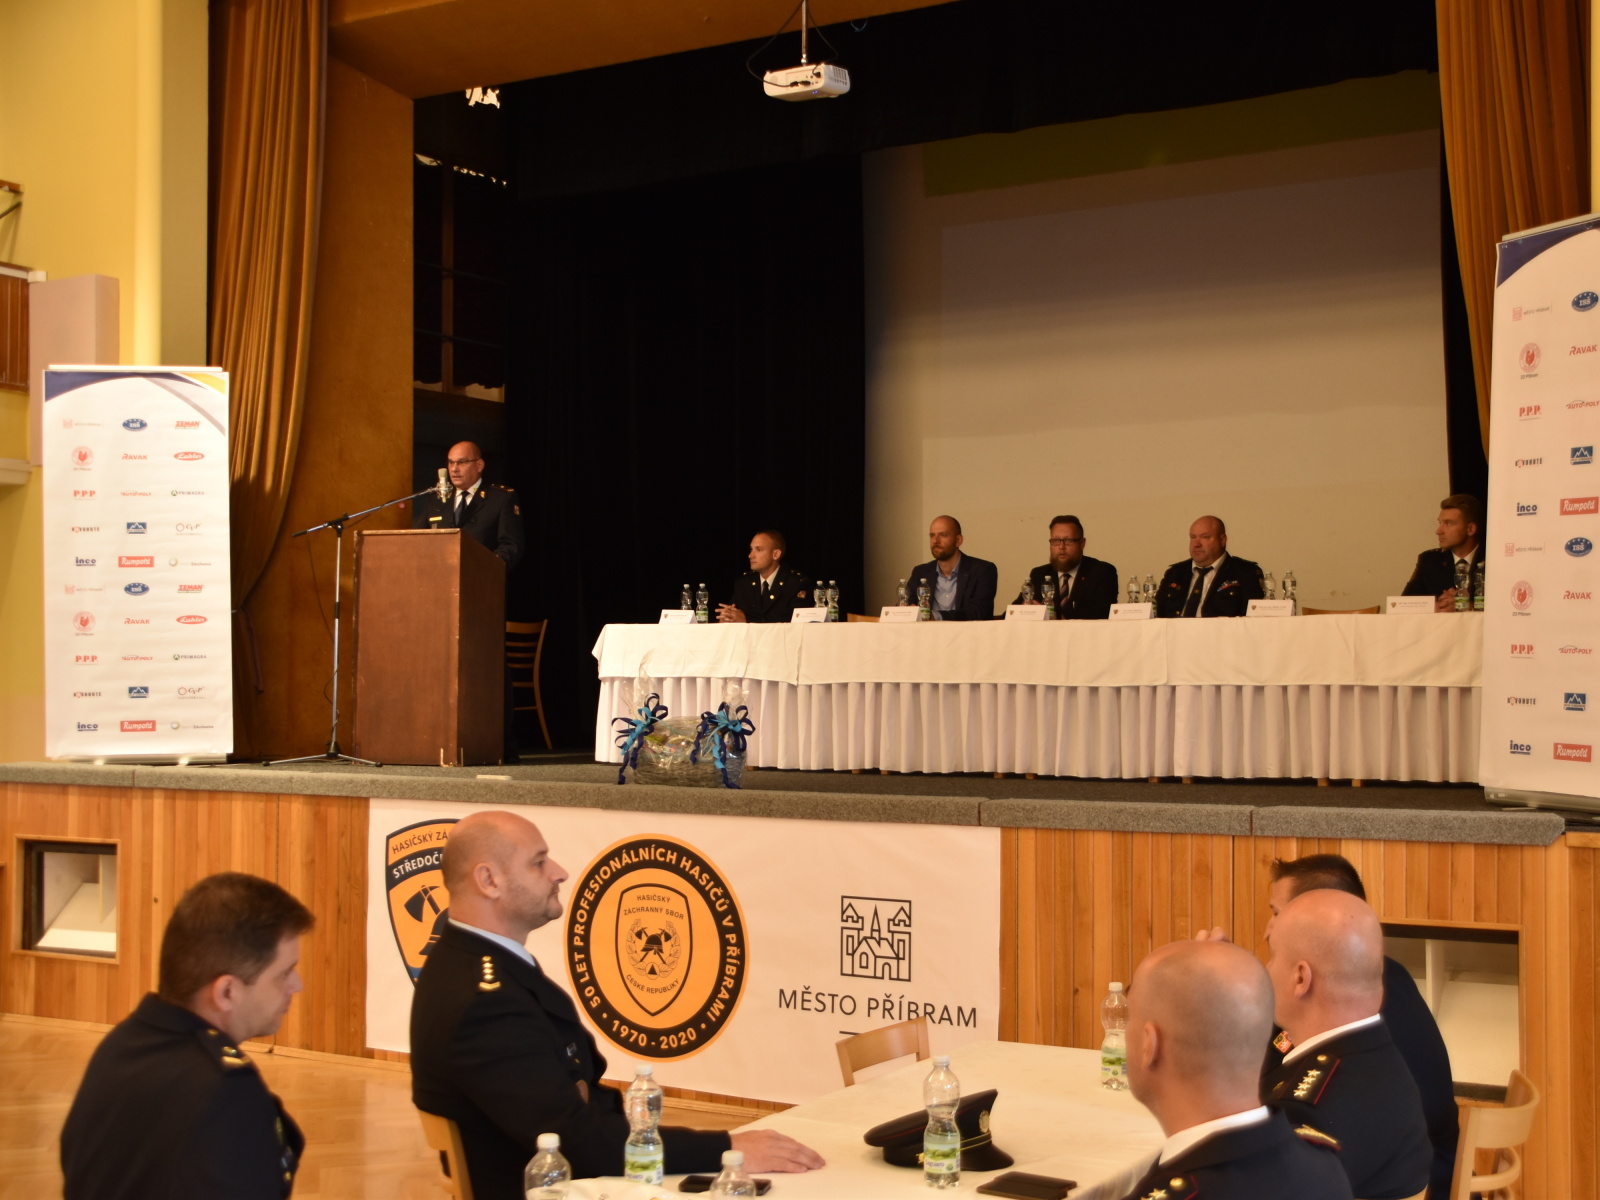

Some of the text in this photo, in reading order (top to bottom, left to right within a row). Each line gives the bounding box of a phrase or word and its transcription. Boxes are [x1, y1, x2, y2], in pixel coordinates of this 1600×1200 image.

[1569, 344, 1598, 356] RAVAK
[122, 453, 148, 461] RAVAK
[1516, 502, 1538, 513] inco
[1563, 499, 1596, 513] Rumpold
[75, 556, 97, 565] inco
[121, 557, 151, 567] Rumpold
[1563, 590, 1592, 600] RAVAK
[124, 617, 150, 625] RAVAK
[77, 721, 99, 730] inco
[123, 721, 153, 732] Rumpold
[1509, 739, 1531, 752] inco
[1556, 744, 1588, 759] Rumpold
[391, 829, 449, 855] HASIČSKÝ ZÁ
[392, 850, 444, 879] STŘEDOČ
[665, 908, 685, 920] SBOR
[573, 843, 741, 1022] 50 LET PROFESIONÁLNÍCH HASIČŮ V PŘÍBRAMI
[626, 973, 680, 995] ČESKÉ REPUBLIKY
[778, 985, 978, 1029] MĚSTO PŘÍBRAM
[611, 1019, 648, 1048] 1970
[659, 1027, 697, 1050] 2020
